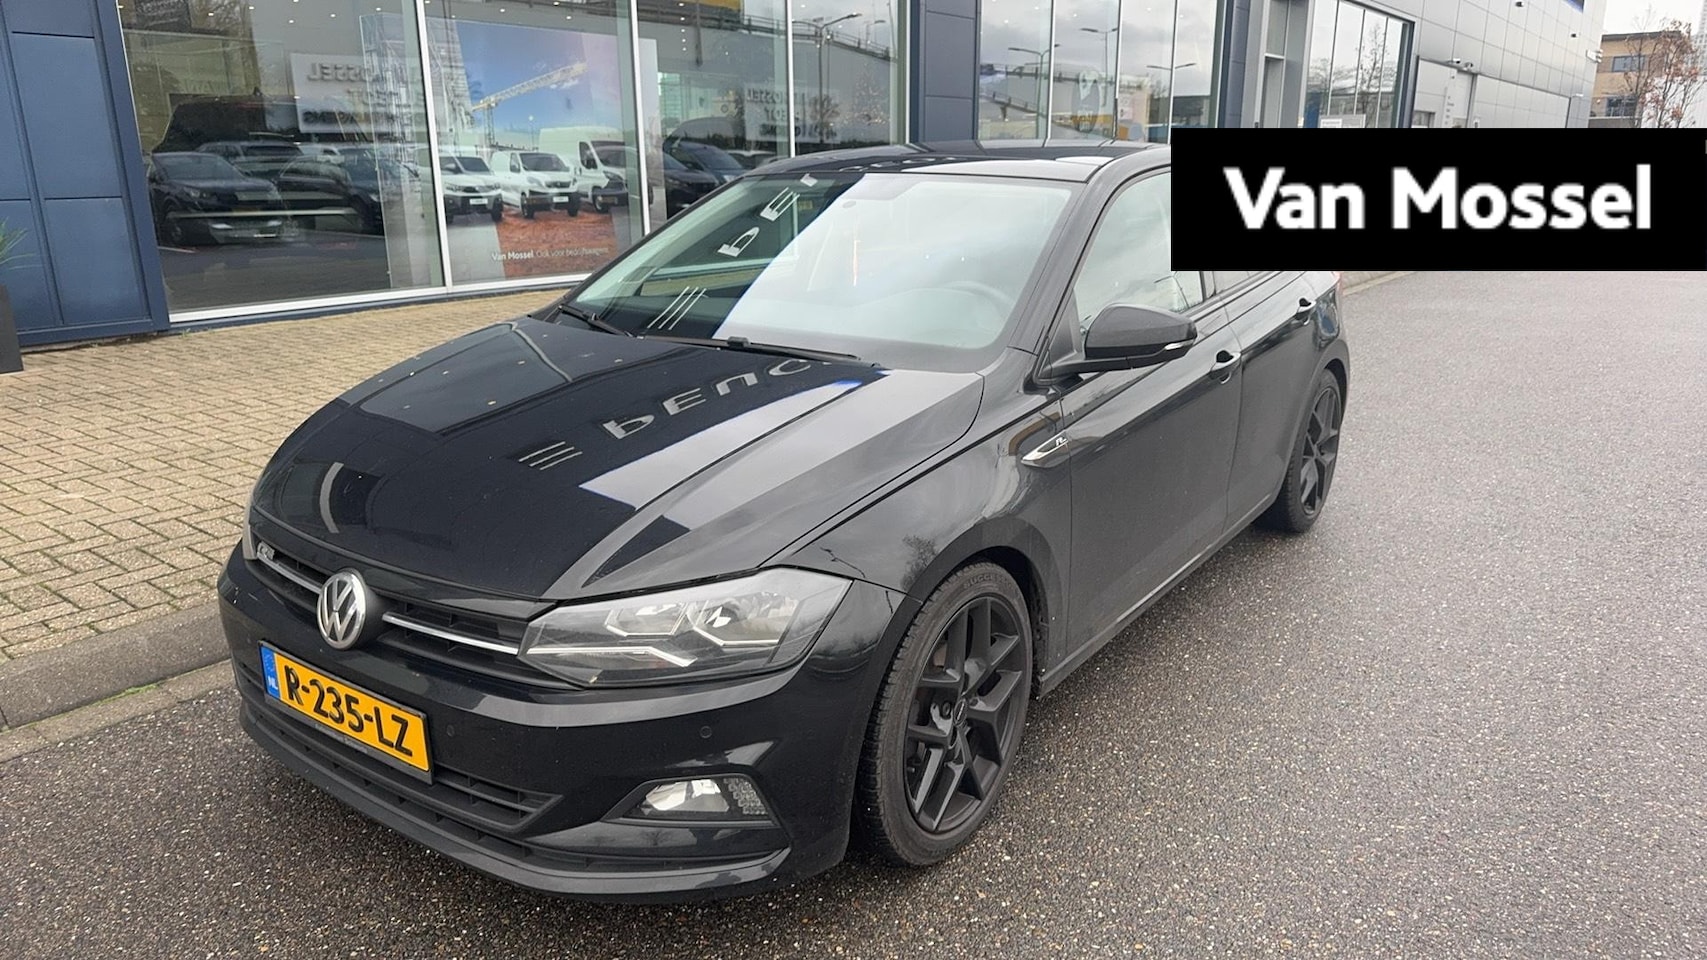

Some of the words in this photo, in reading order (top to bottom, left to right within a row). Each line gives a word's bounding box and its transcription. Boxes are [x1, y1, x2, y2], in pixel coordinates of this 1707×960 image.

[491, 251, 506, 261] Van
[507, 249, 534, 260] Mossel
[284, 665, 413, 757] R-235-LZ
